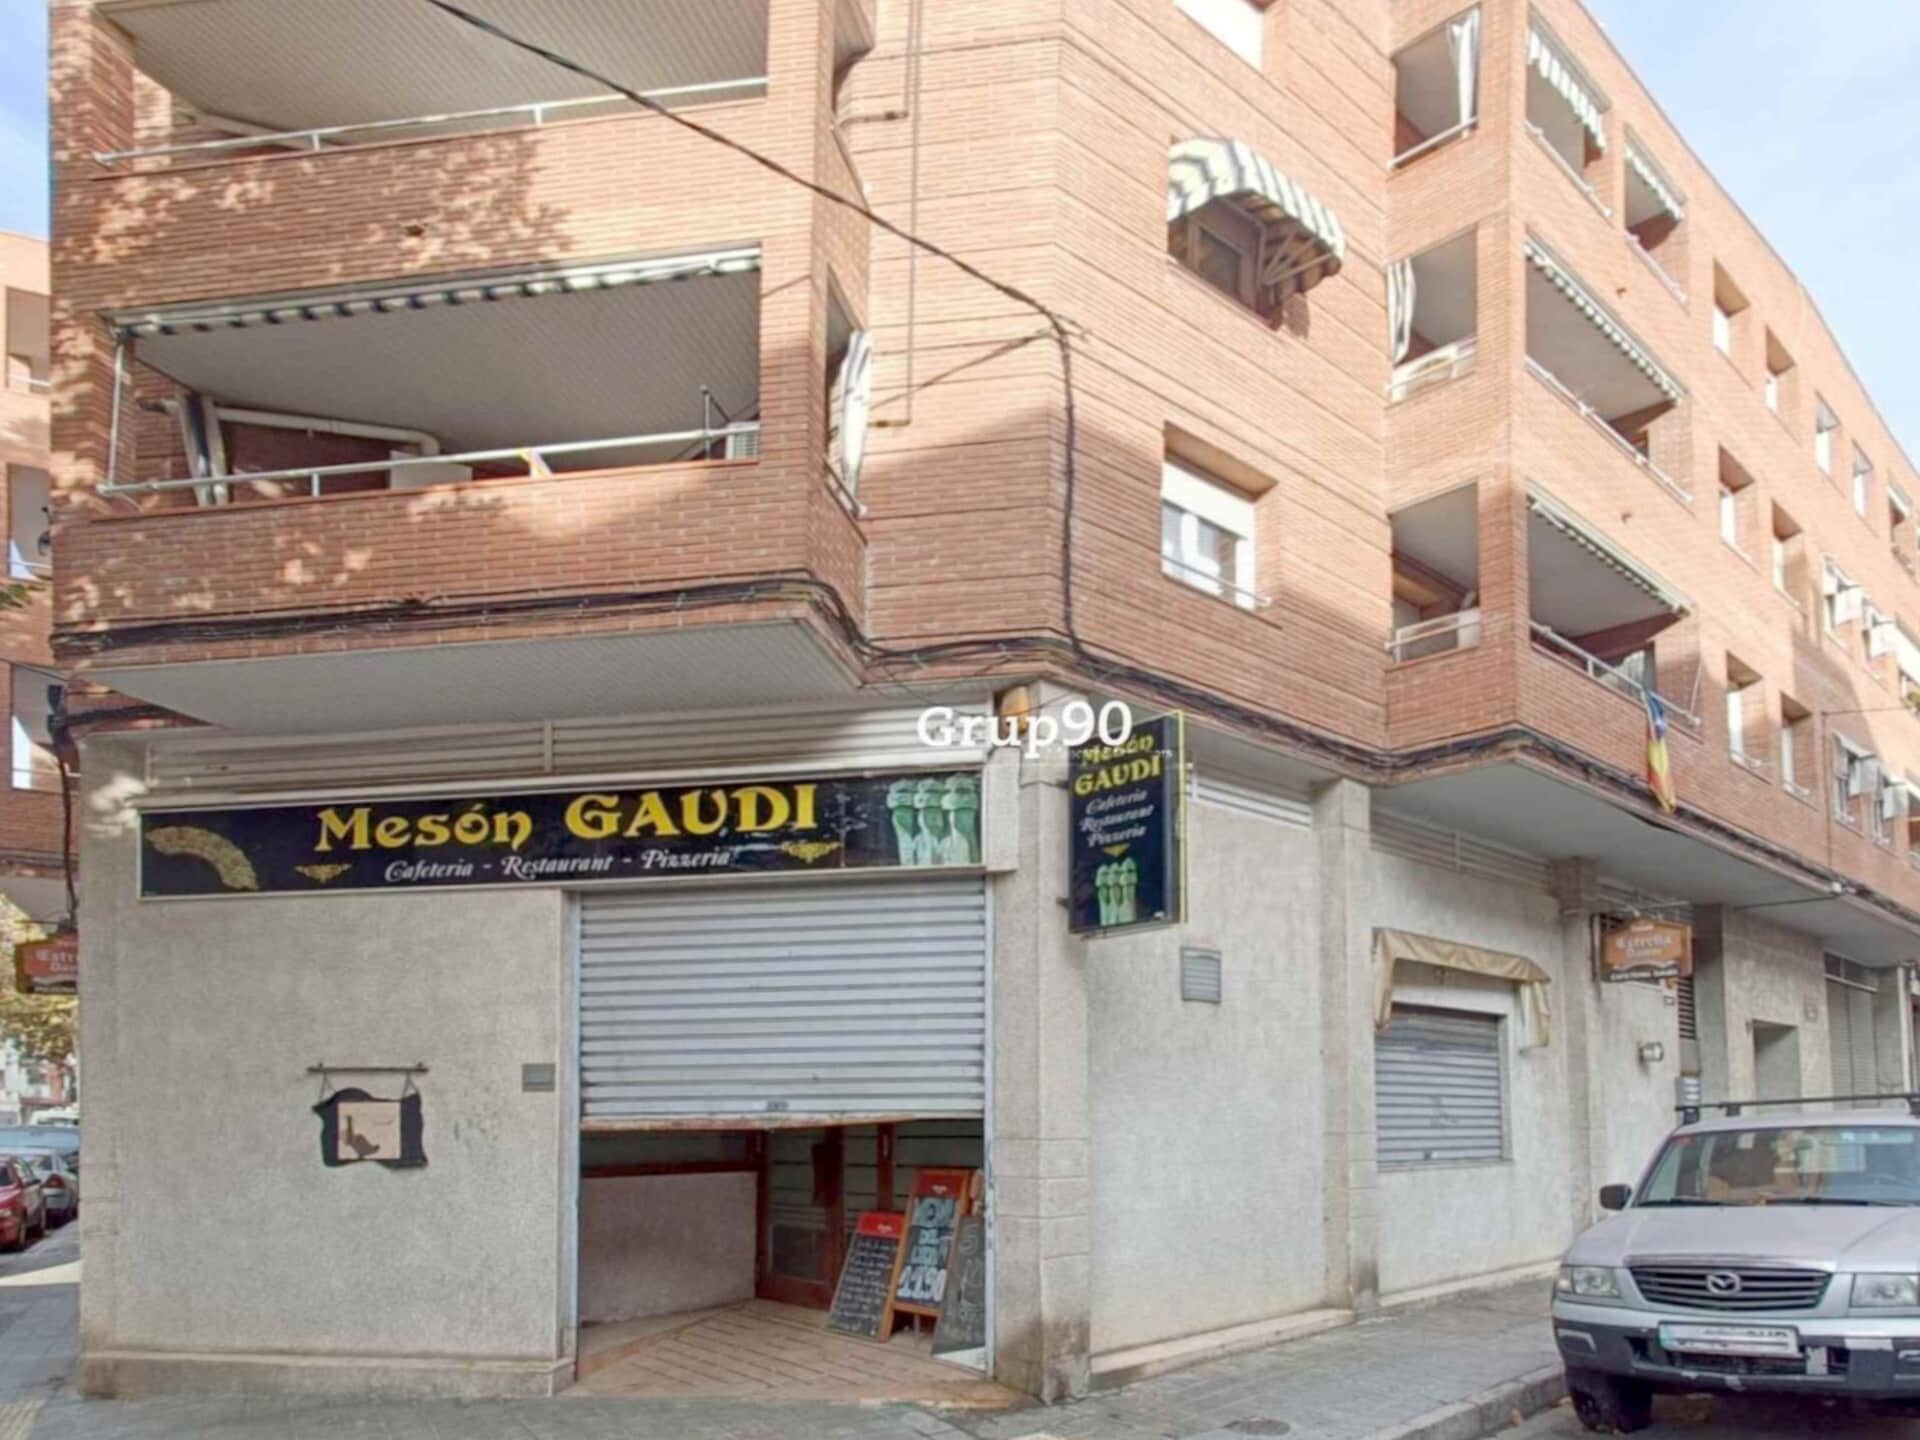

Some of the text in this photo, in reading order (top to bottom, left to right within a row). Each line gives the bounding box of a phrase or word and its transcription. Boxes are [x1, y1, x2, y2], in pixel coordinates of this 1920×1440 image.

[1074, 754, 1161, 795] GAUDI
[313, 783, 818, 852] Mesón GAUDI
[384, 859, 474, 882] Cafeteria
[500, 855, 614, 880] Restaurant
[641, 848, 731, 870] Pizzeria
